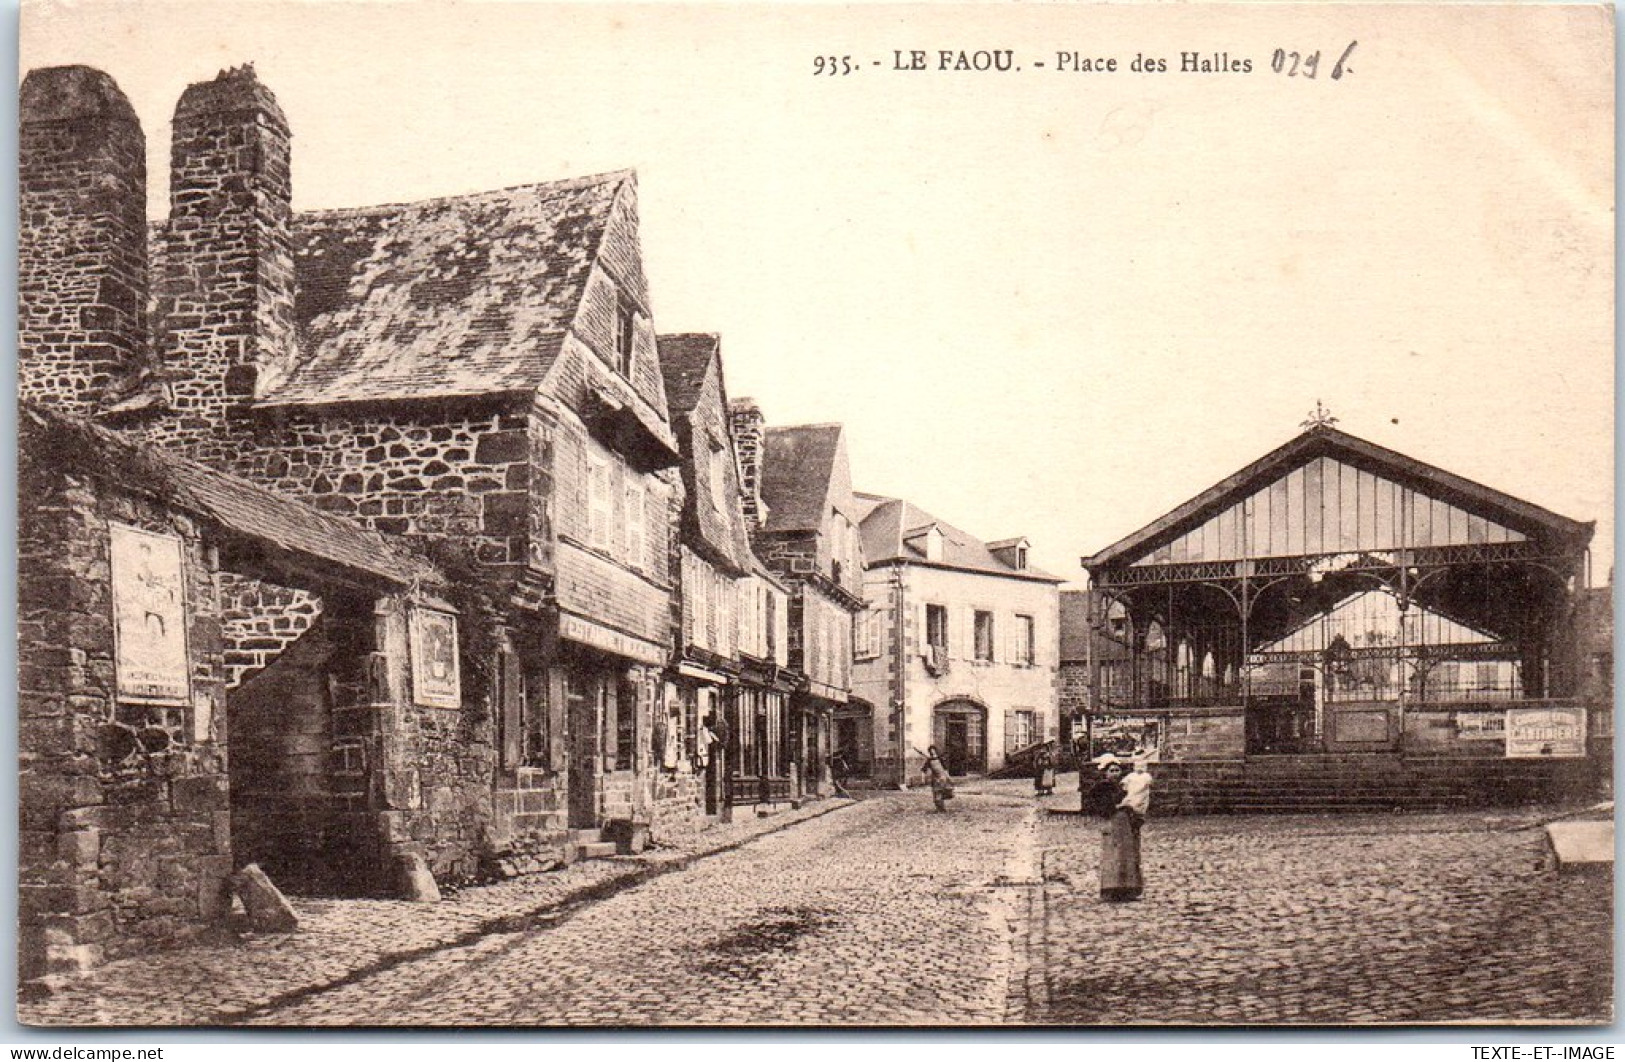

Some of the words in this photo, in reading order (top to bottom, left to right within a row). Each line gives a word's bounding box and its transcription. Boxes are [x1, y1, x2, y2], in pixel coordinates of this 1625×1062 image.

[813, 56, 860, 76] 935.
[893, 50, 927, 71] LE
[938, 50, 1021, 72] FAOU.
[1056, 51, 1118, 72] Place
[1130, 52, 1167, 73] des
[1180, 51, 1253, 73] Halles
